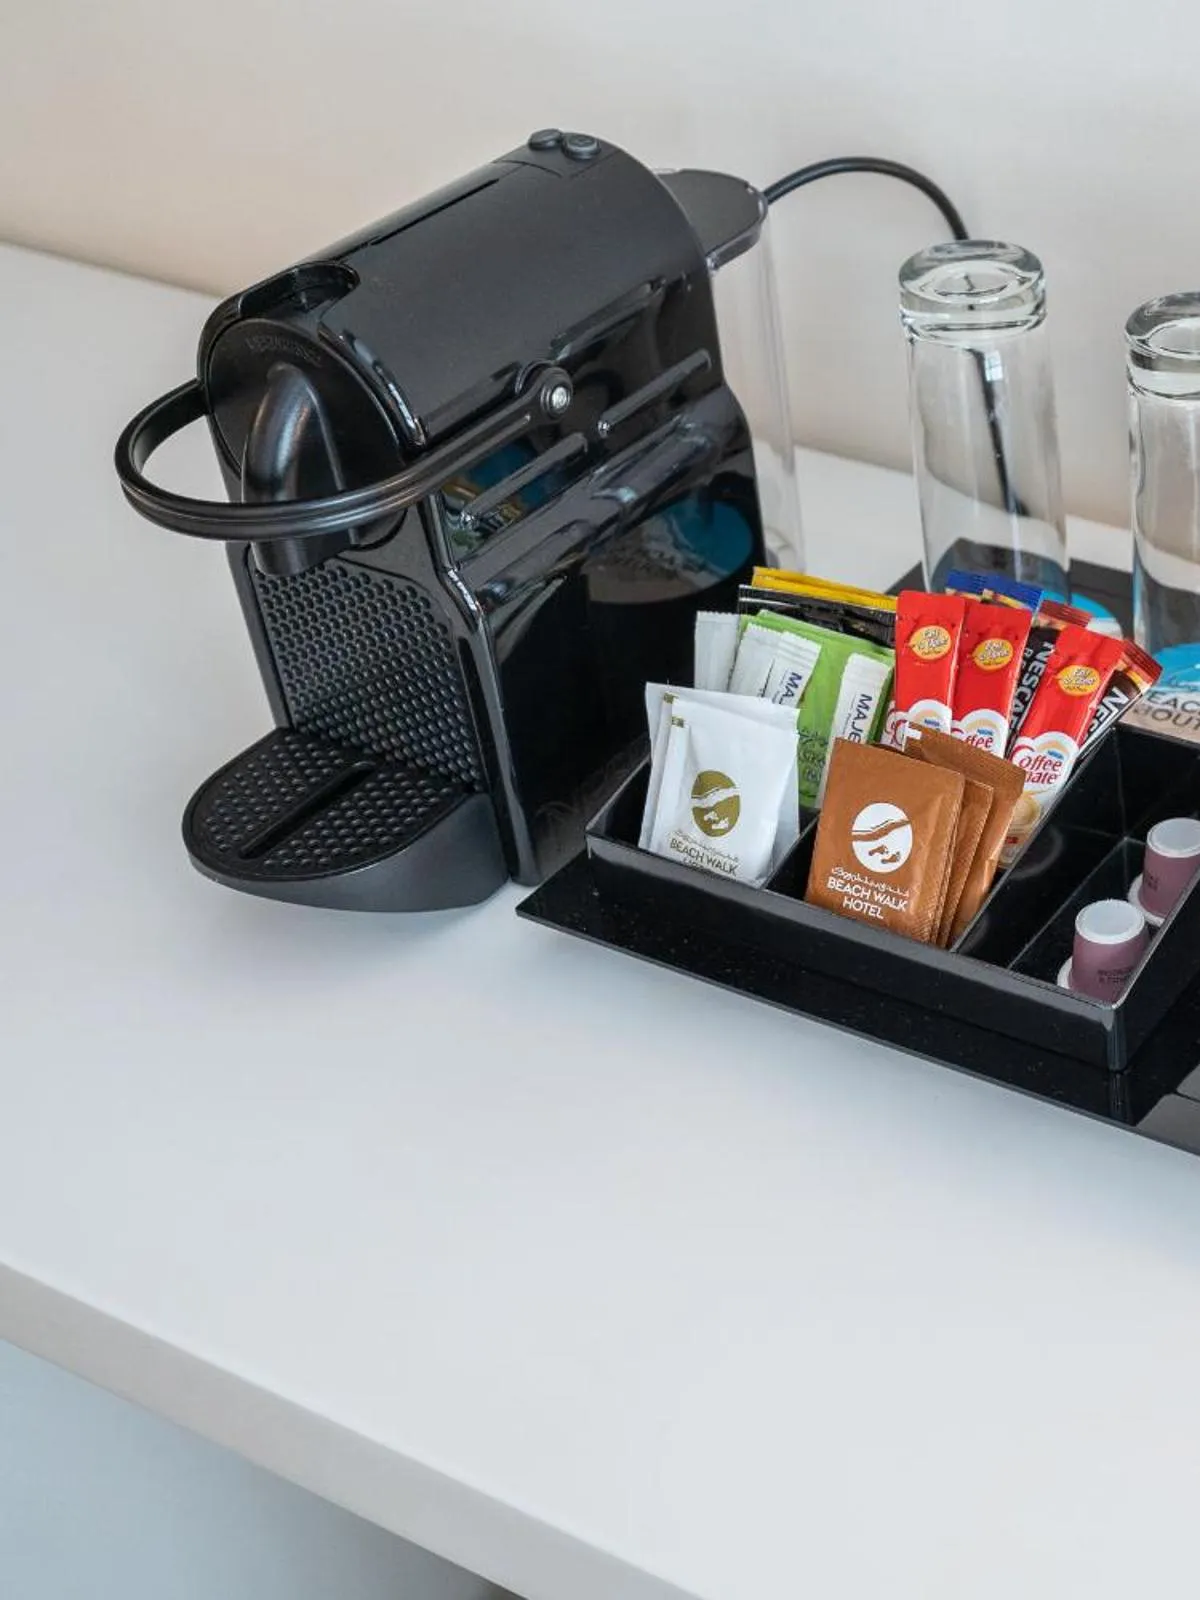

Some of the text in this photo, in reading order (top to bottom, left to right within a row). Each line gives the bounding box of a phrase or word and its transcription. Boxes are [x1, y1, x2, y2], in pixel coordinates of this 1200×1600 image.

[670, 838, 705, 863] BEACH
[706, 854, 739, 877] WALK
[827, 876, 871, 900] BEACH
[873, 890, 909, 913] WALK
[842, 895, 885, 920] HOTEL
